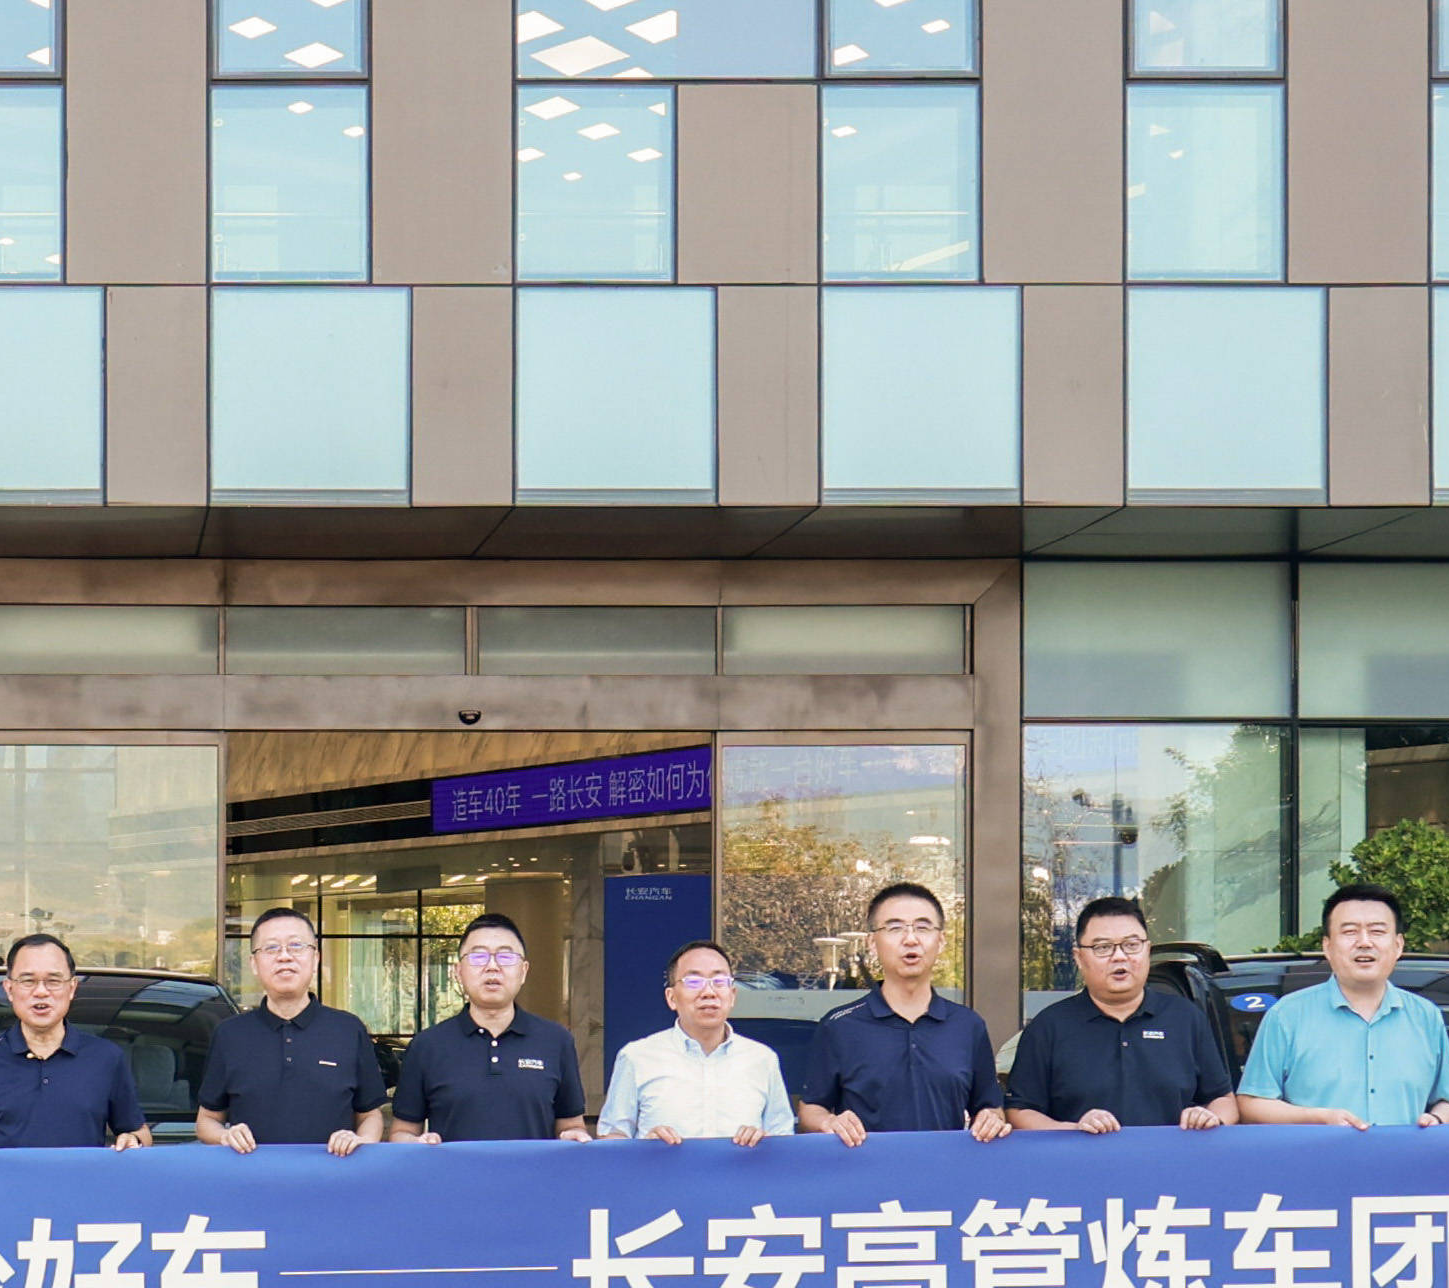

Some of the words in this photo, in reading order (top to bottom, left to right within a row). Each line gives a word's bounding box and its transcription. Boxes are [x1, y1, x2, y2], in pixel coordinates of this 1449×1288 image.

[451, 781, 522, 822] 造车40年
[530, 772, 603, 812] 一路长安
[608, 760, 711, 807] 解密如何为
[1245, 996, 1266, 1009] 2
